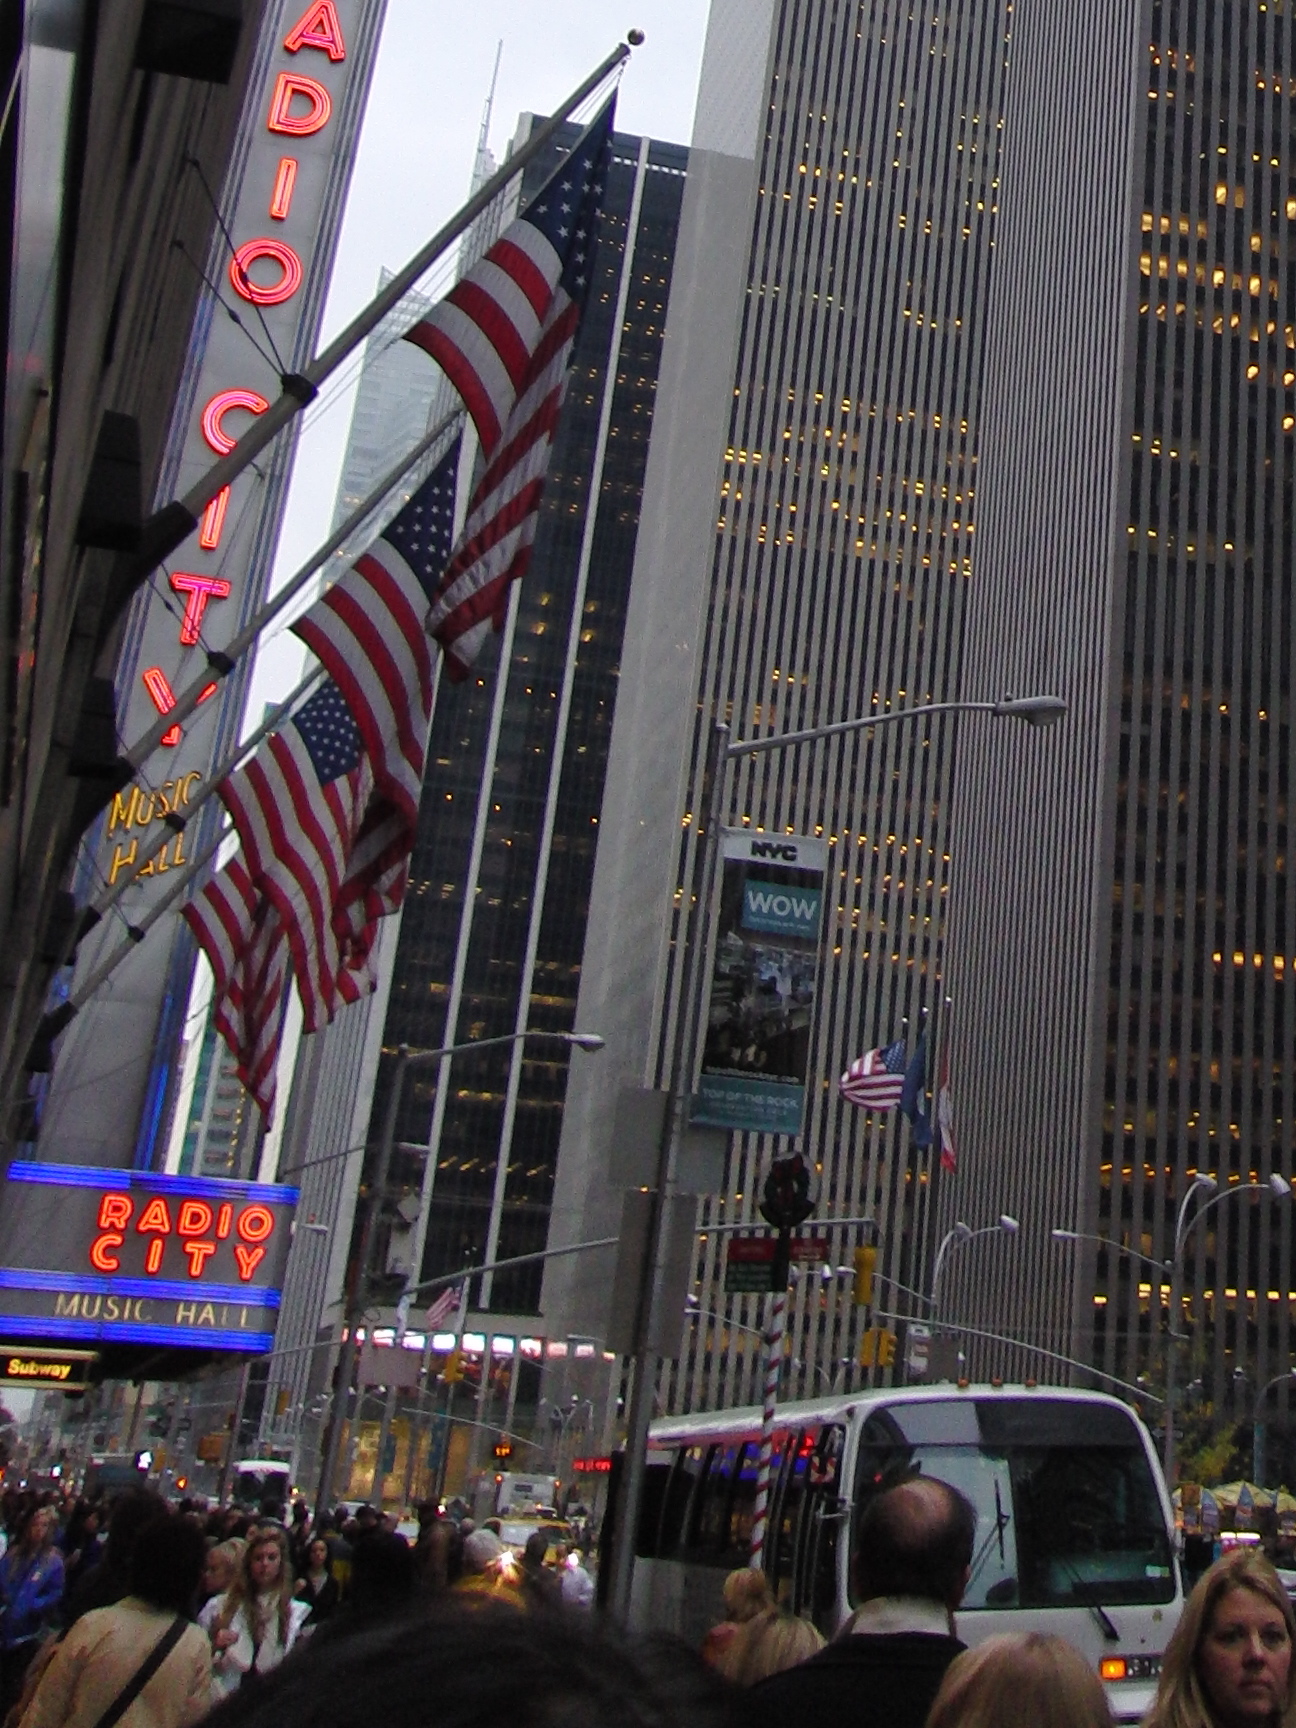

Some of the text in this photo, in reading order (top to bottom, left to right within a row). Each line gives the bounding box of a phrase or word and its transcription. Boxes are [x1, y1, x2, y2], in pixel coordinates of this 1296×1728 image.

[751, 839, 798, 861] NYC
[748, 890, 817, 921] WOW
[98, 1192, 275, 1243] RADIO
[90, 1232, 266, 1281] CITY
[54, 1293, 251, 1328] MUSIC HALL
[8, 1358, 71, 1381] Subway
